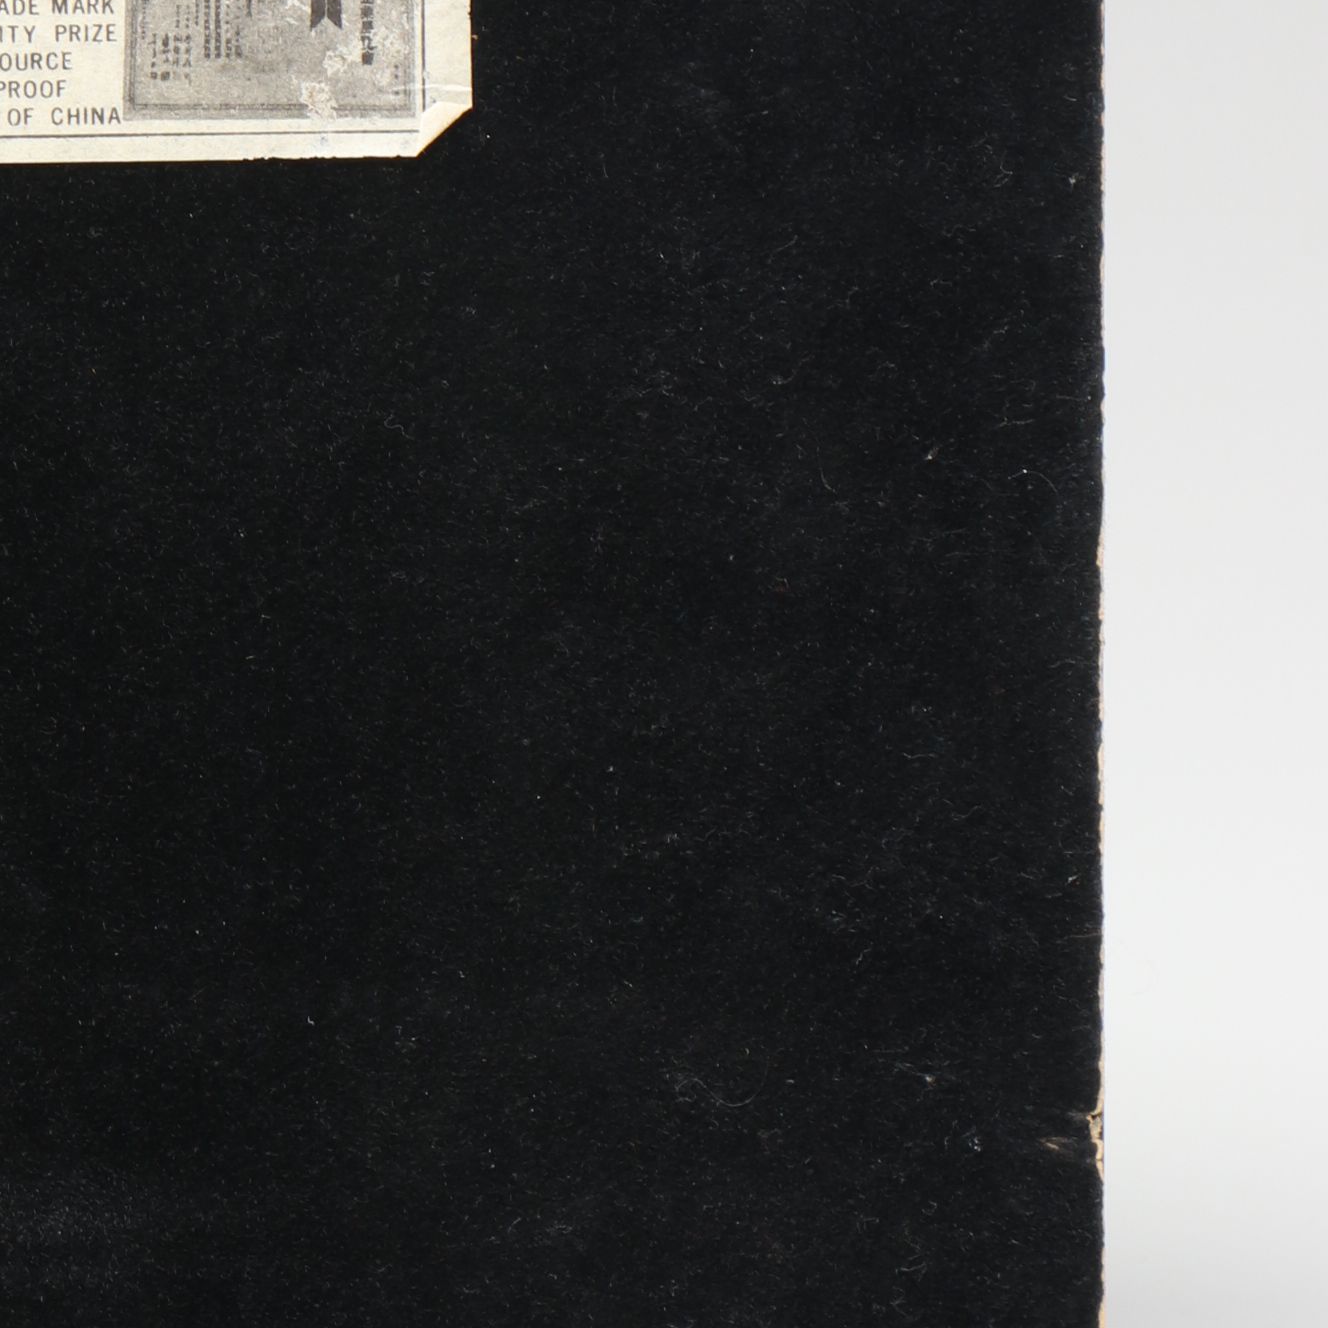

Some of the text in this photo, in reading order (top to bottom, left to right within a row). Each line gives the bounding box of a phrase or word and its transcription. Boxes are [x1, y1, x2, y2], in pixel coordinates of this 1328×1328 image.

[55, 23, 116, 42] PRIZE
[7, 107, 32, 127] OF
[51, 107, 122, 126] CHINA
